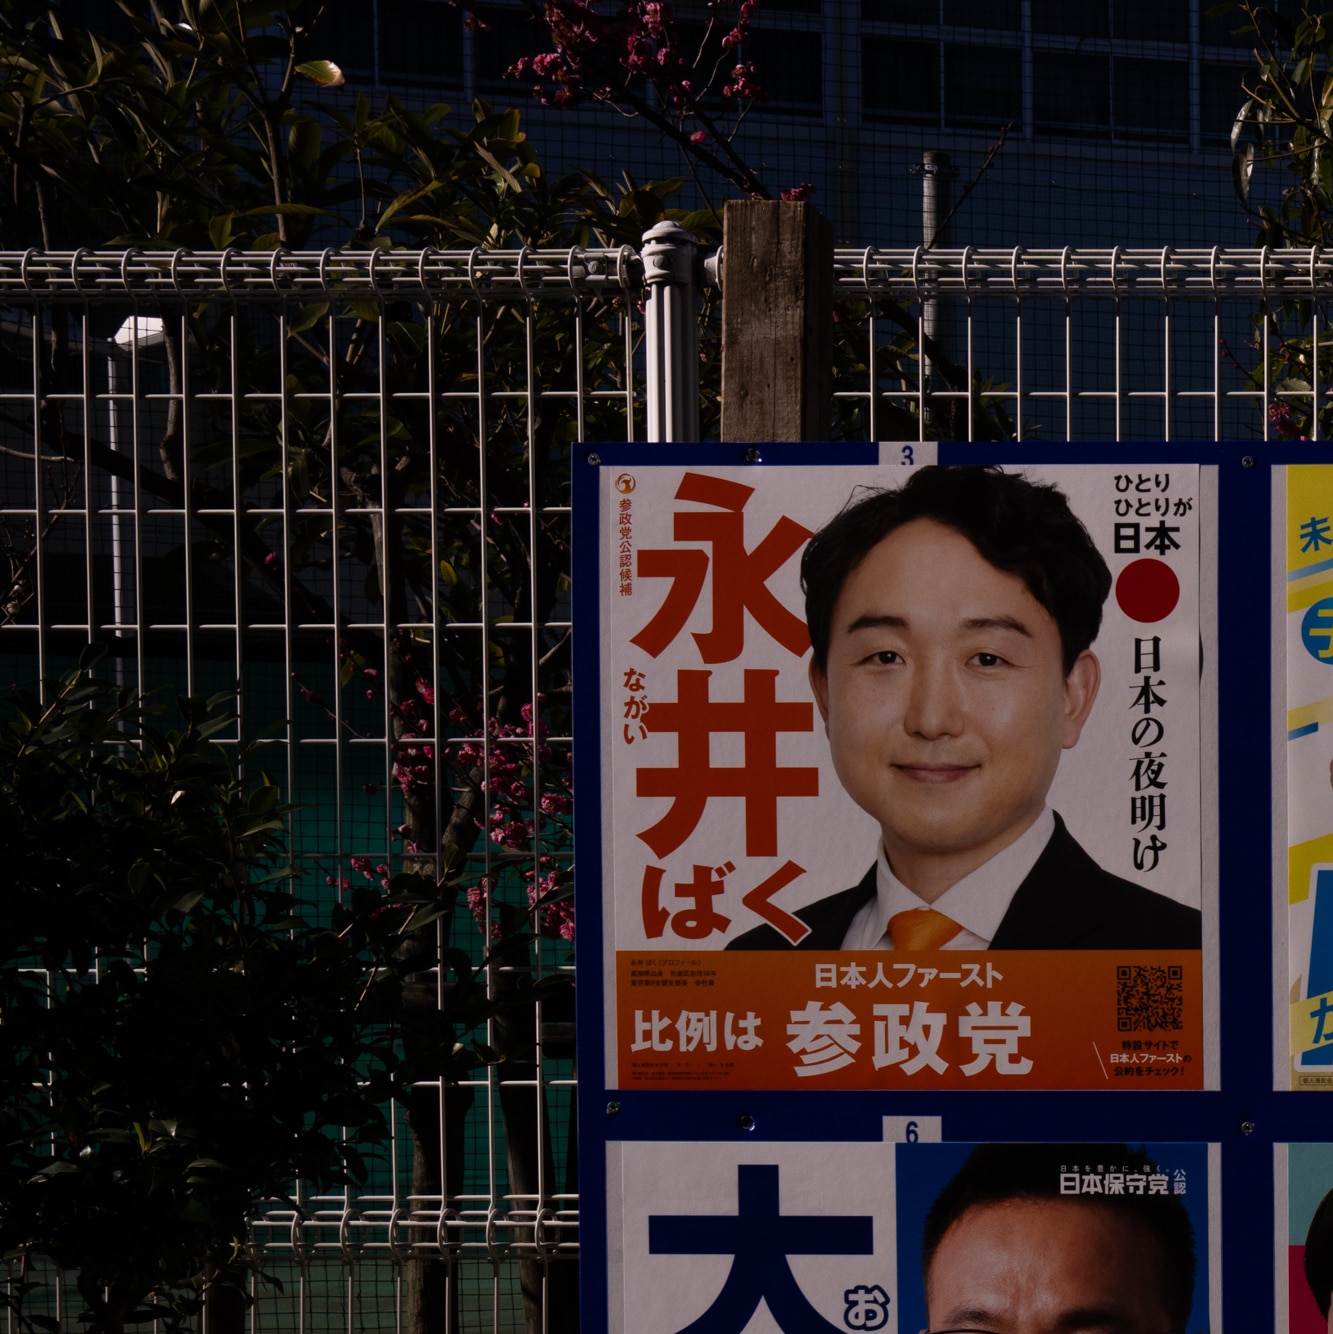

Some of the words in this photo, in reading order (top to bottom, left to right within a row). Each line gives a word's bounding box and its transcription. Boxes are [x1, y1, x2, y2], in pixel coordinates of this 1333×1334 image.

[901, 445, 914, 466] 3
[1114, 473, 1171, 494] ひとり
[1114, 496, 1193, 518] ひとりが
[618, 498, 633, 597] 参政党公認候補
[1114, 521, 1181, 556] 日本
[629, 472, 818, 858] 永井
[623, 668, 649, 745] ながい
[1128, 636, 1168, 873] 日本の夜明け
[641, 860, 813, 945] ばく
[813, 962, 1004, 990] 日本人ファースト
[630, 1009, 764, 1053] 比例は
[785, 1000, 1034, 1077] 参政党
[1121, 1040, 1179, 1051] 特設サイトで
[1109, 1052, 1192, 1064] 日本人ファーストの
[906, 1121, 918, 1143] 6
[1059, 1173, 1170, 1195] 日本保守党
[1173, 1168, 1187, 1195] 公認
